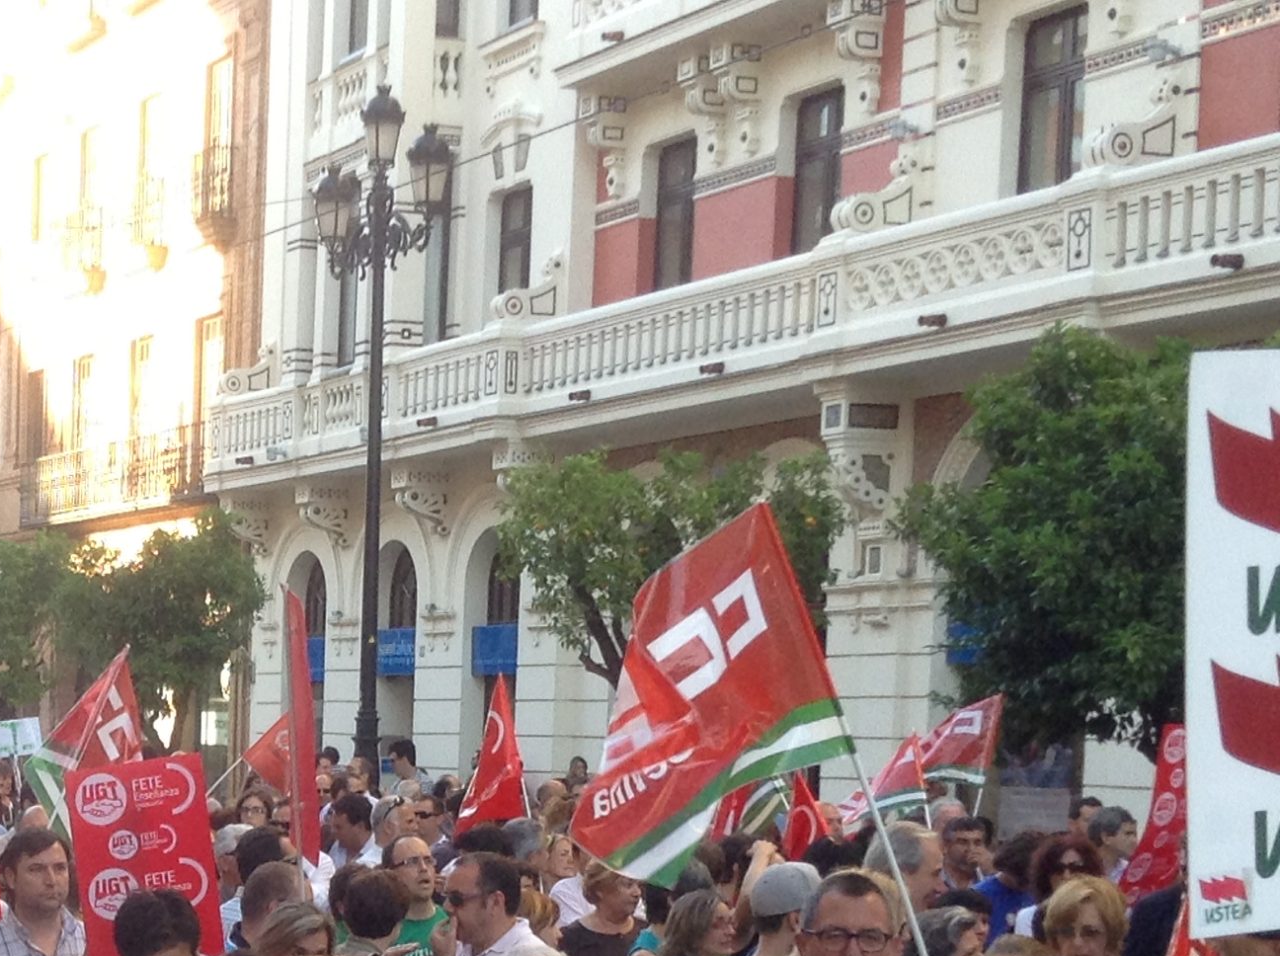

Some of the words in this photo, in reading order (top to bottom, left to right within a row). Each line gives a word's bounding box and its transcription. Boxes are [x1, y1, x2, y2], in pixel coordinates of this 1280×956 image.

[81, 780, 119, 806] UGT
[132, 775, 164, 792] FETE
[112, 834, 134, 848] UGT
[95, 875, 131, 900] UGT
[144, 869, 177, 886] FETE
[1204, 902, 1252, 925] USTEA
